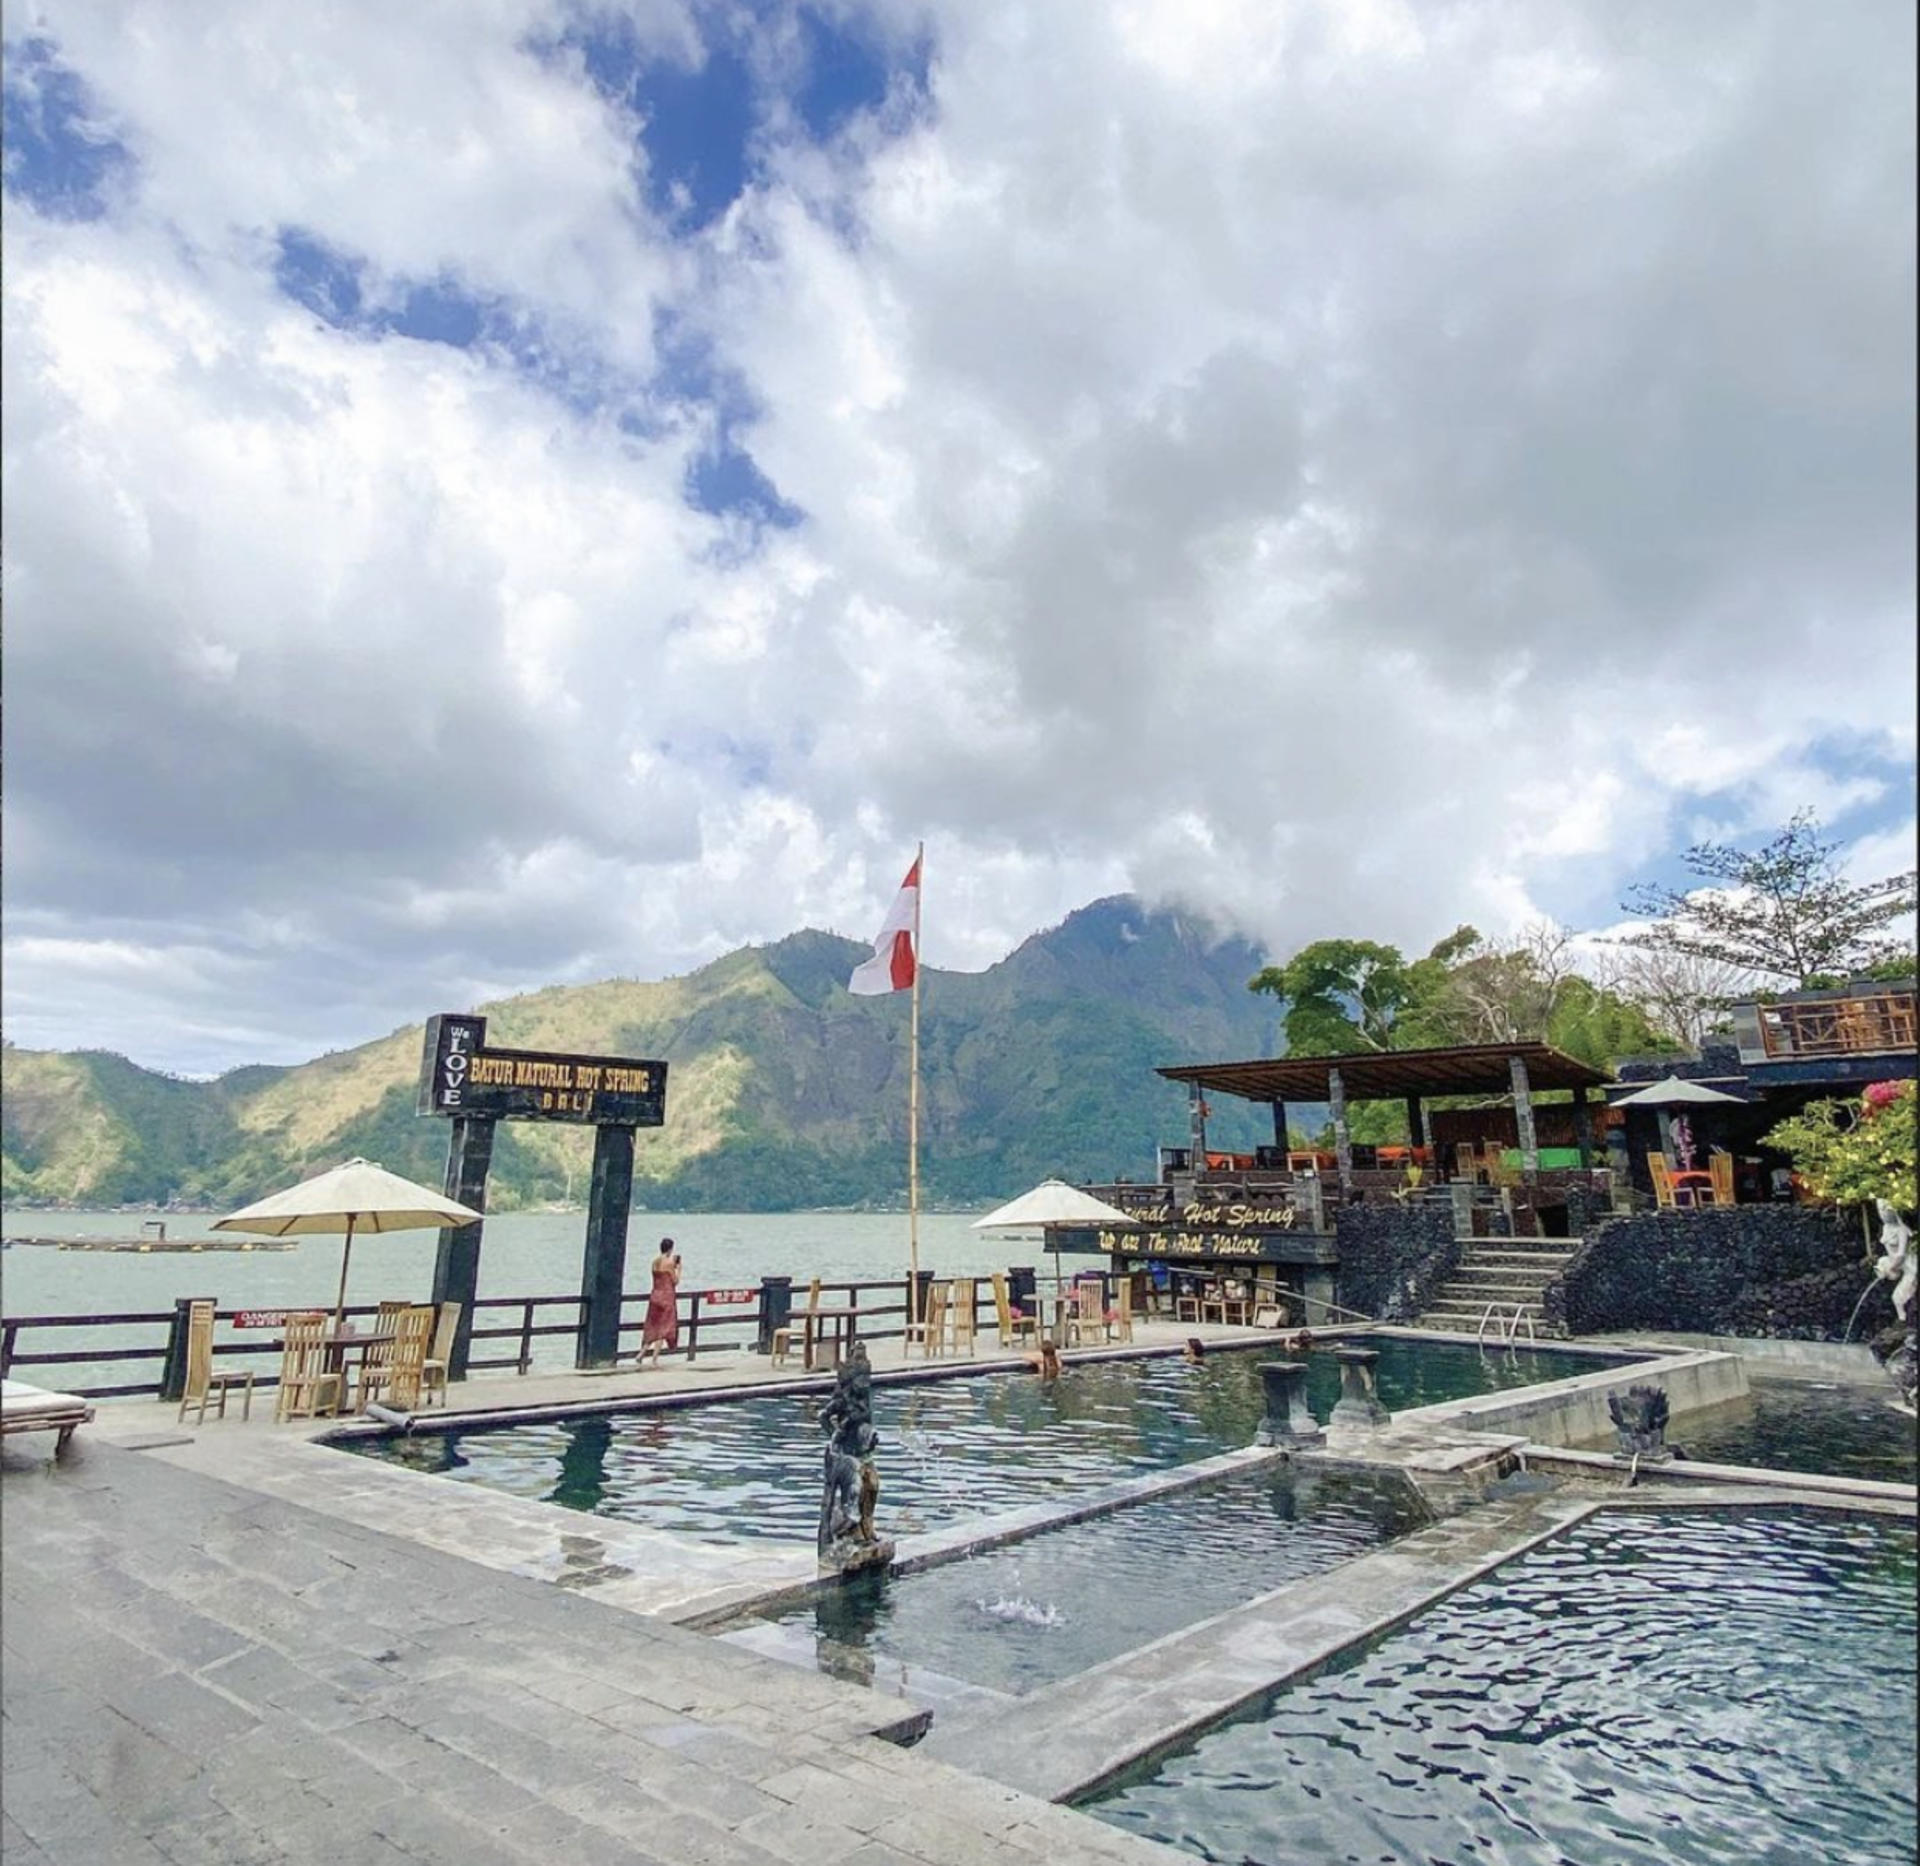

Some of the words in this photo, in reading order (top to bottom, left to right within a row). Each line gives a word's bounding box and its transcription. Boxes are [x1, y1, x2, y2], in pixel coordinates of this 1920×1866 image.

[450, 1026, 470, 1040] We
[443, 1038, 467, 1105] LOVE
[470, 1057, 513, 1085] BATUR
[515, 1061, 573, 1089] NATURAL
[576, 1066, 601, 1091] HOT
[604, 1068, 650, 1093] SPRING
[1183, 1202, 1221, 1225] Hot
[1226, 1204, 1294, 1229] Spring
[1148, 1231, 1168, 1251] The
